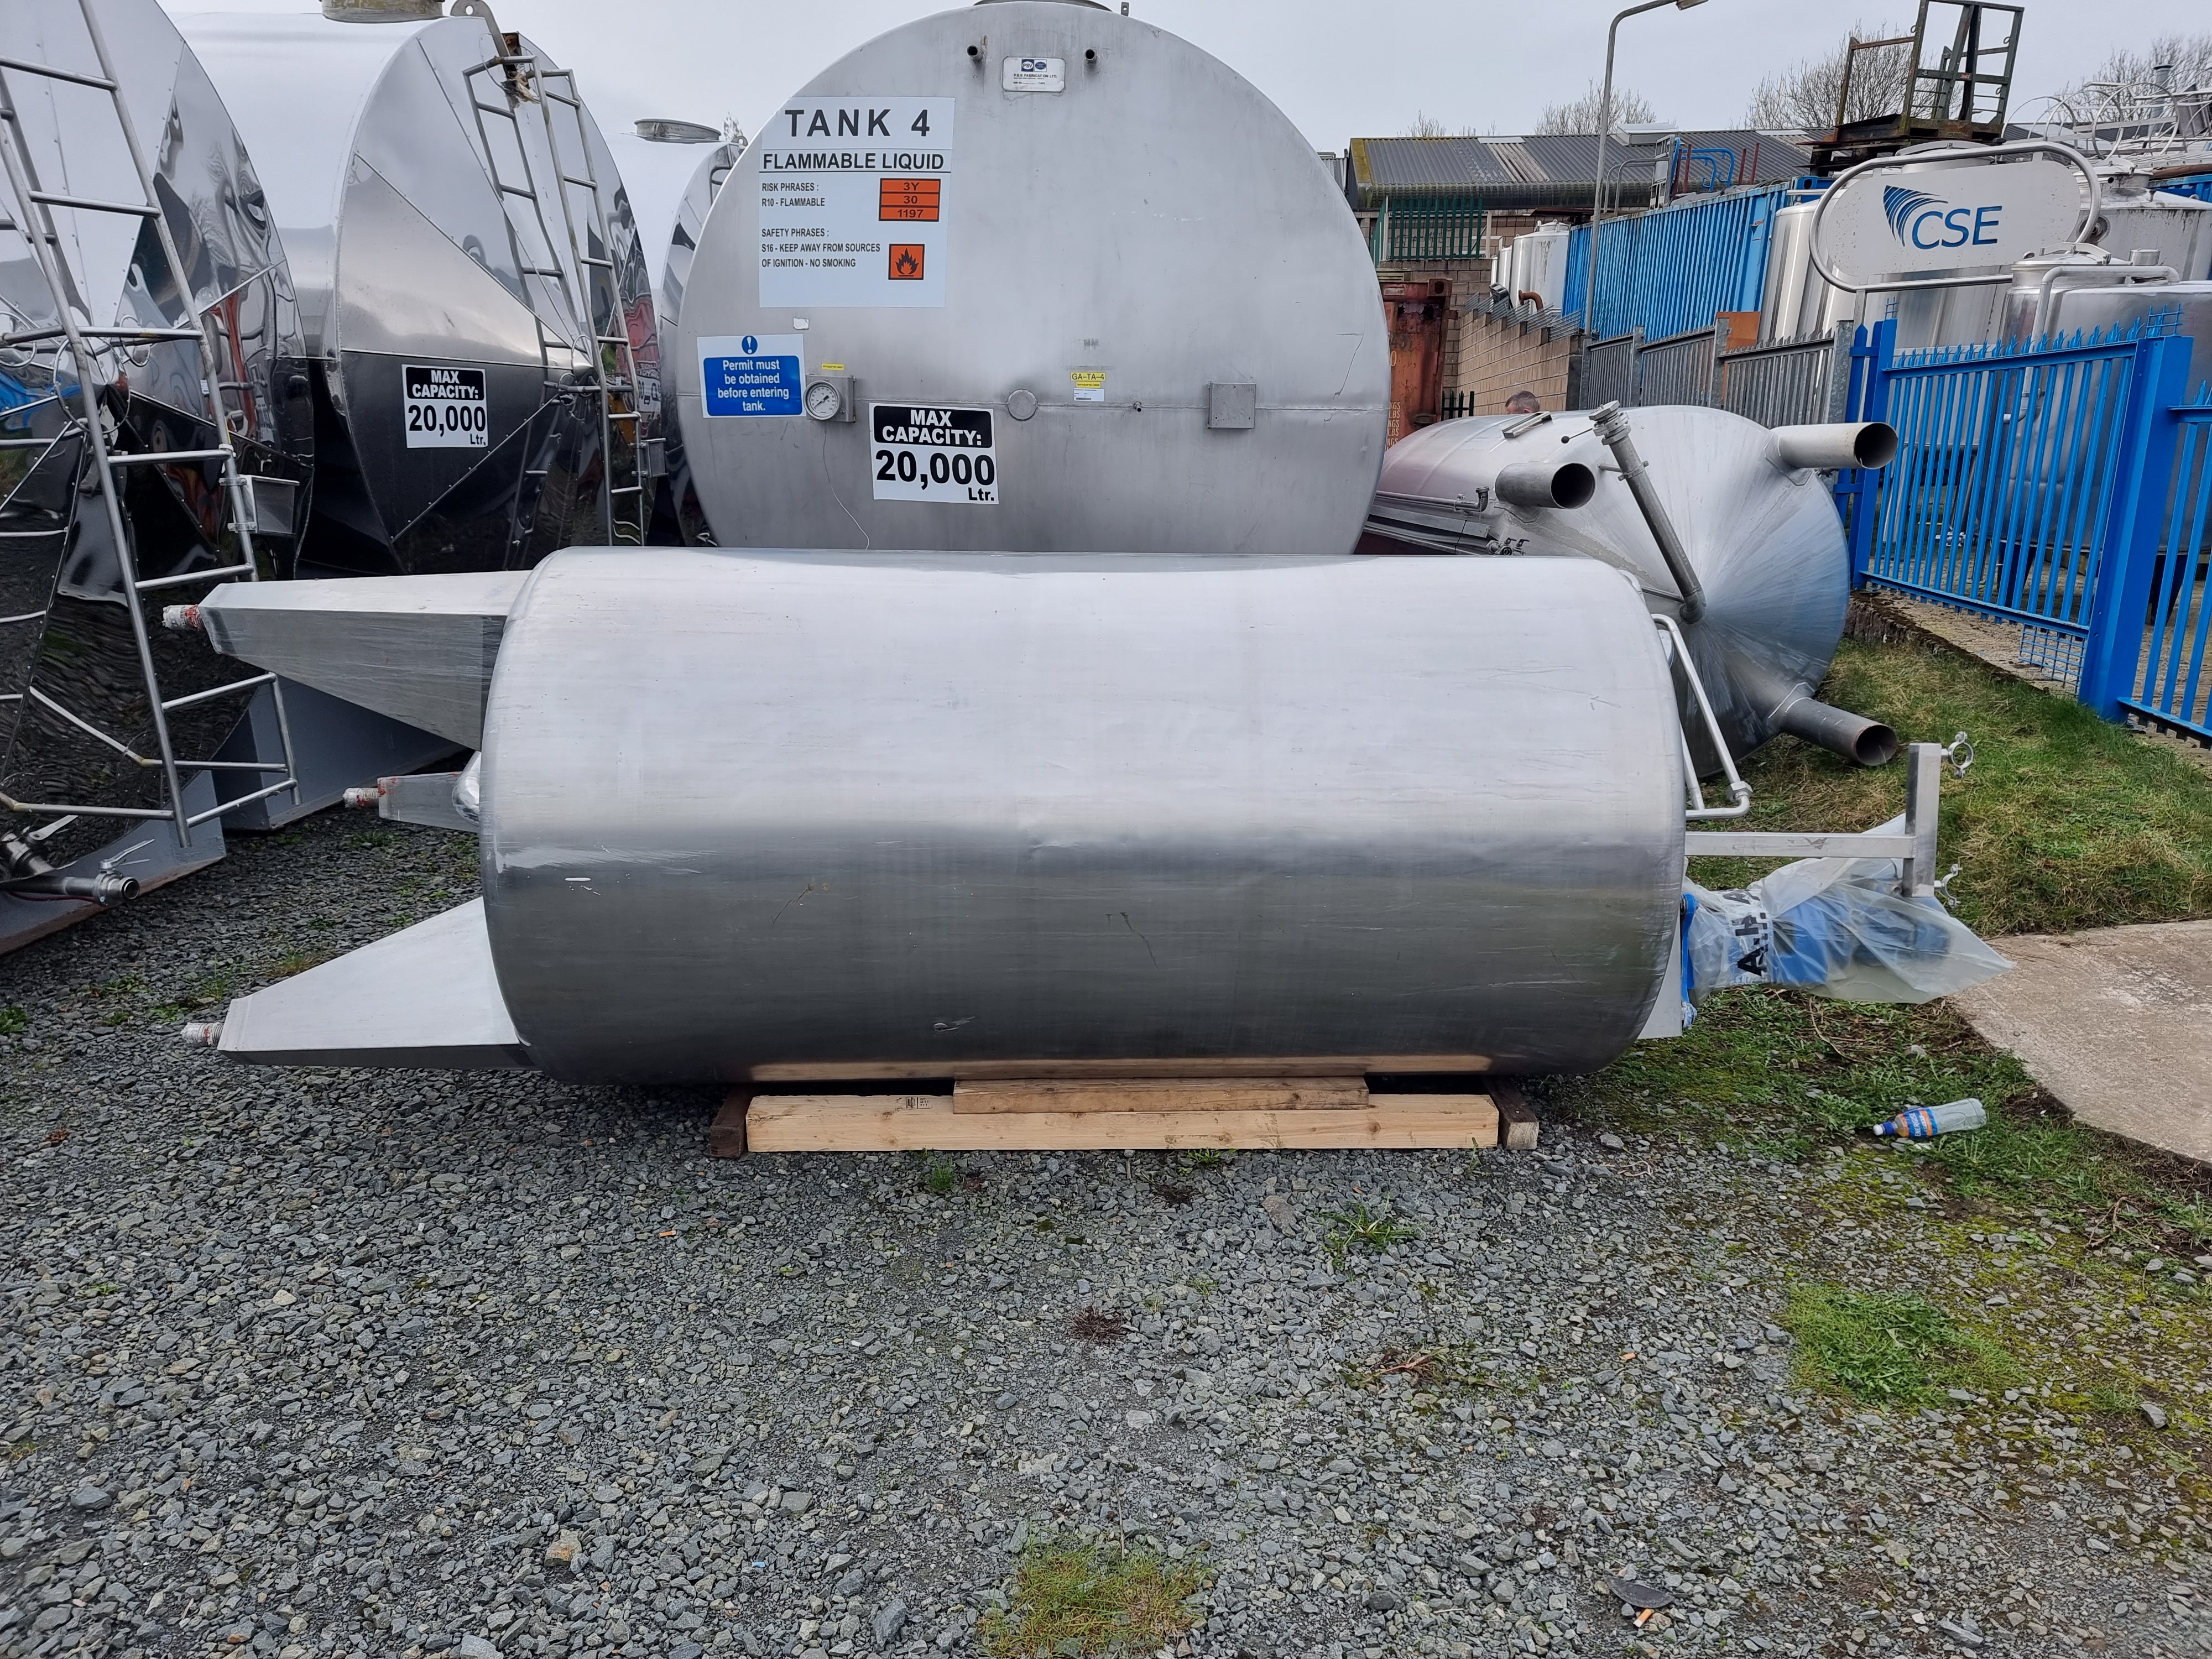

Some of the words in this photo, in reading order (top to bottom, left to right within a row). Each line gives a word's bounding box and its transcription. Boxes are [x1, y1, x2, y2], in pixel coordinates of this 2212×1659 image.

[785, 109, 891, 137] TANK
[911, 109, 930, 137] 4
[763, 153, 876, 169] FLAMMABLE
[883, 153, 944, 170] LIQUID
[762, 182, 779, 191] RISK
[780, 182, 815, 191] PHRASES
[903, 182, 920, 191] 3Y
[762, 199, 774, 207] R10
[780, 197, 826, 207] FLAMMABLE
[904, 195, 918, 205] 30
[897, 209, 924, 218] 1197
[761, 229, 790, 237] SAFETY
[791, 228, 825, 237] PHRASES
[1912, 205, 2003, 249] CSE
[761, 244, 774, 252] S16
[779, 244, 799, 252] KEEP
[800, 244, 821, 252] AWAY
[823, 243, 843, 252] FROM
[845, 243, 880, 252] SOURCES
[762, 259, 771, 268] OF
[773, 259, 804, 268] IGNITION
[810, 258, 821, 267] NO
[822, 258, 856, 267] SMOKING
[723, 359, 754, 371] Permit
[756, 359, 780, 370] must
[431, 370, 460, 384] MAX
[724, 373, 737, 384] be
[739, 372, 780, 384] obtained
[412, 384, 479, 399] CAPACITY:
[718, 387, 748, 398] before
[750, 387, 789, 400] entering
[743, 400, 766, 411] tank.
[408, 405, 486, 438] 20,000
[911, 409, 952, 427] MAX
[470, 433, 486, 446] Ltr.
[882, 425, 982, 446] CAPACITY:
[875, 450, 995, 491] 20,000
[968, 487, 994, 501] Ltr.
